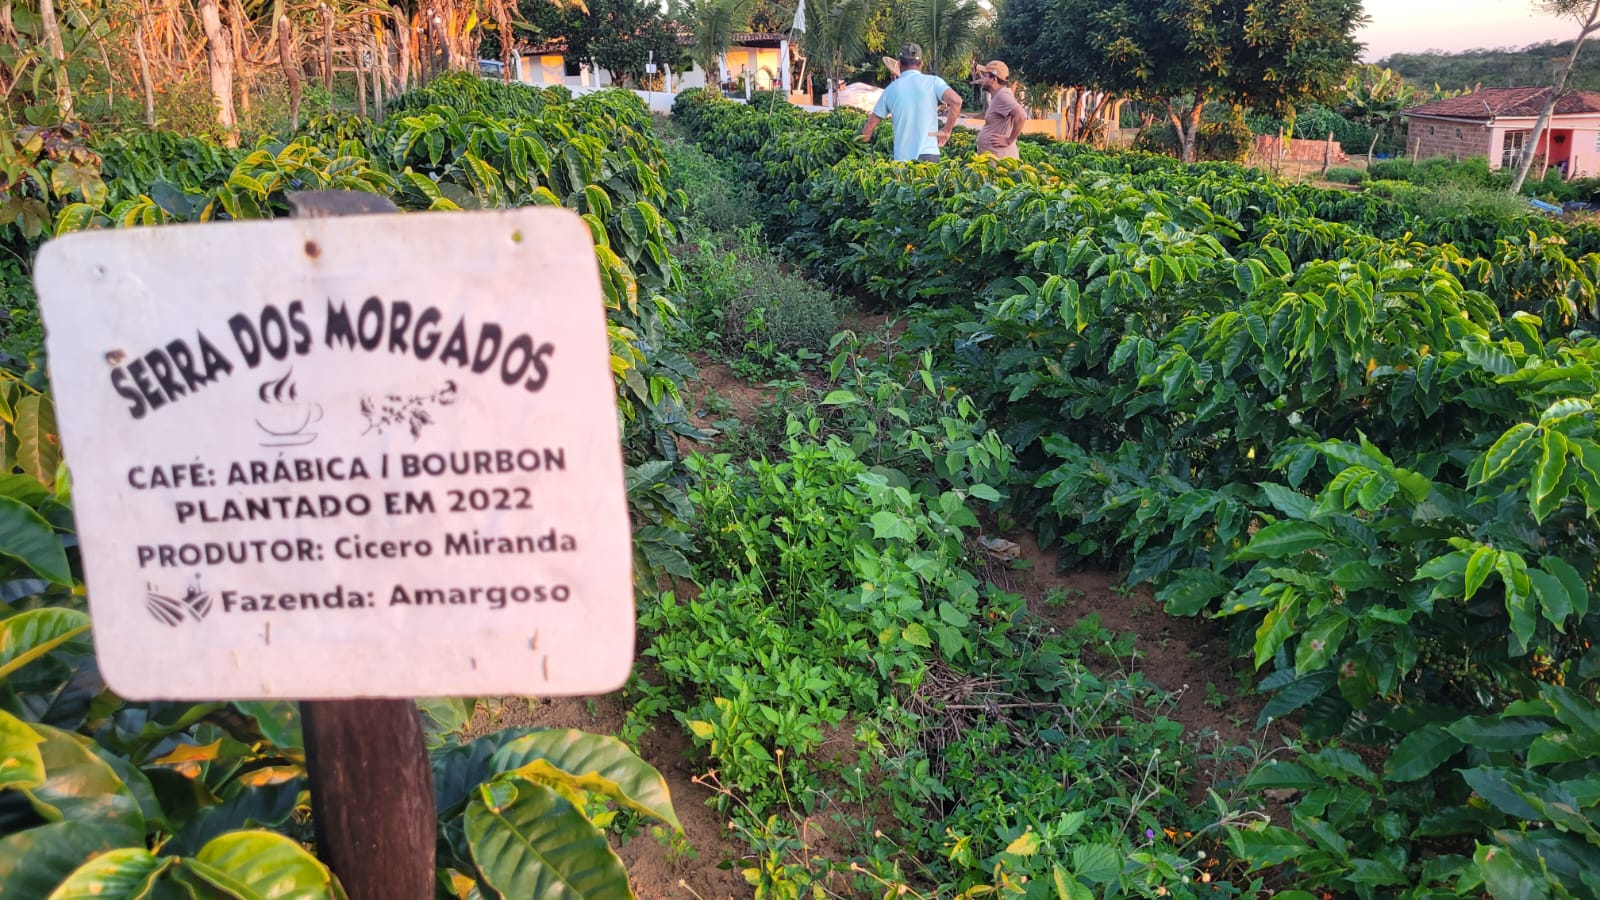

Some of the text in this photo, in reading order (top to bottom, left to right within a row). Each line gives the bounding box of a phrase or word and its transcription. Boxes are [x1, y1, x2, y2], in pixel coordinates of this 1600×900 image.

[110, 296, 555, 420] SERRA DOS MORGADOS
[127, 456, 216, 491] CAFÉ:
[227, 453, 371, 486] ARÁBICA
[400, 447, 567, 479] BOURBON
[174, 486, 534, 524] PLANTADO EM 2022
[136, 527, 578, 569] PRODUTOR: Cicero Miranda
[220, 584, 571, 614] Fazenda: Amargoso
